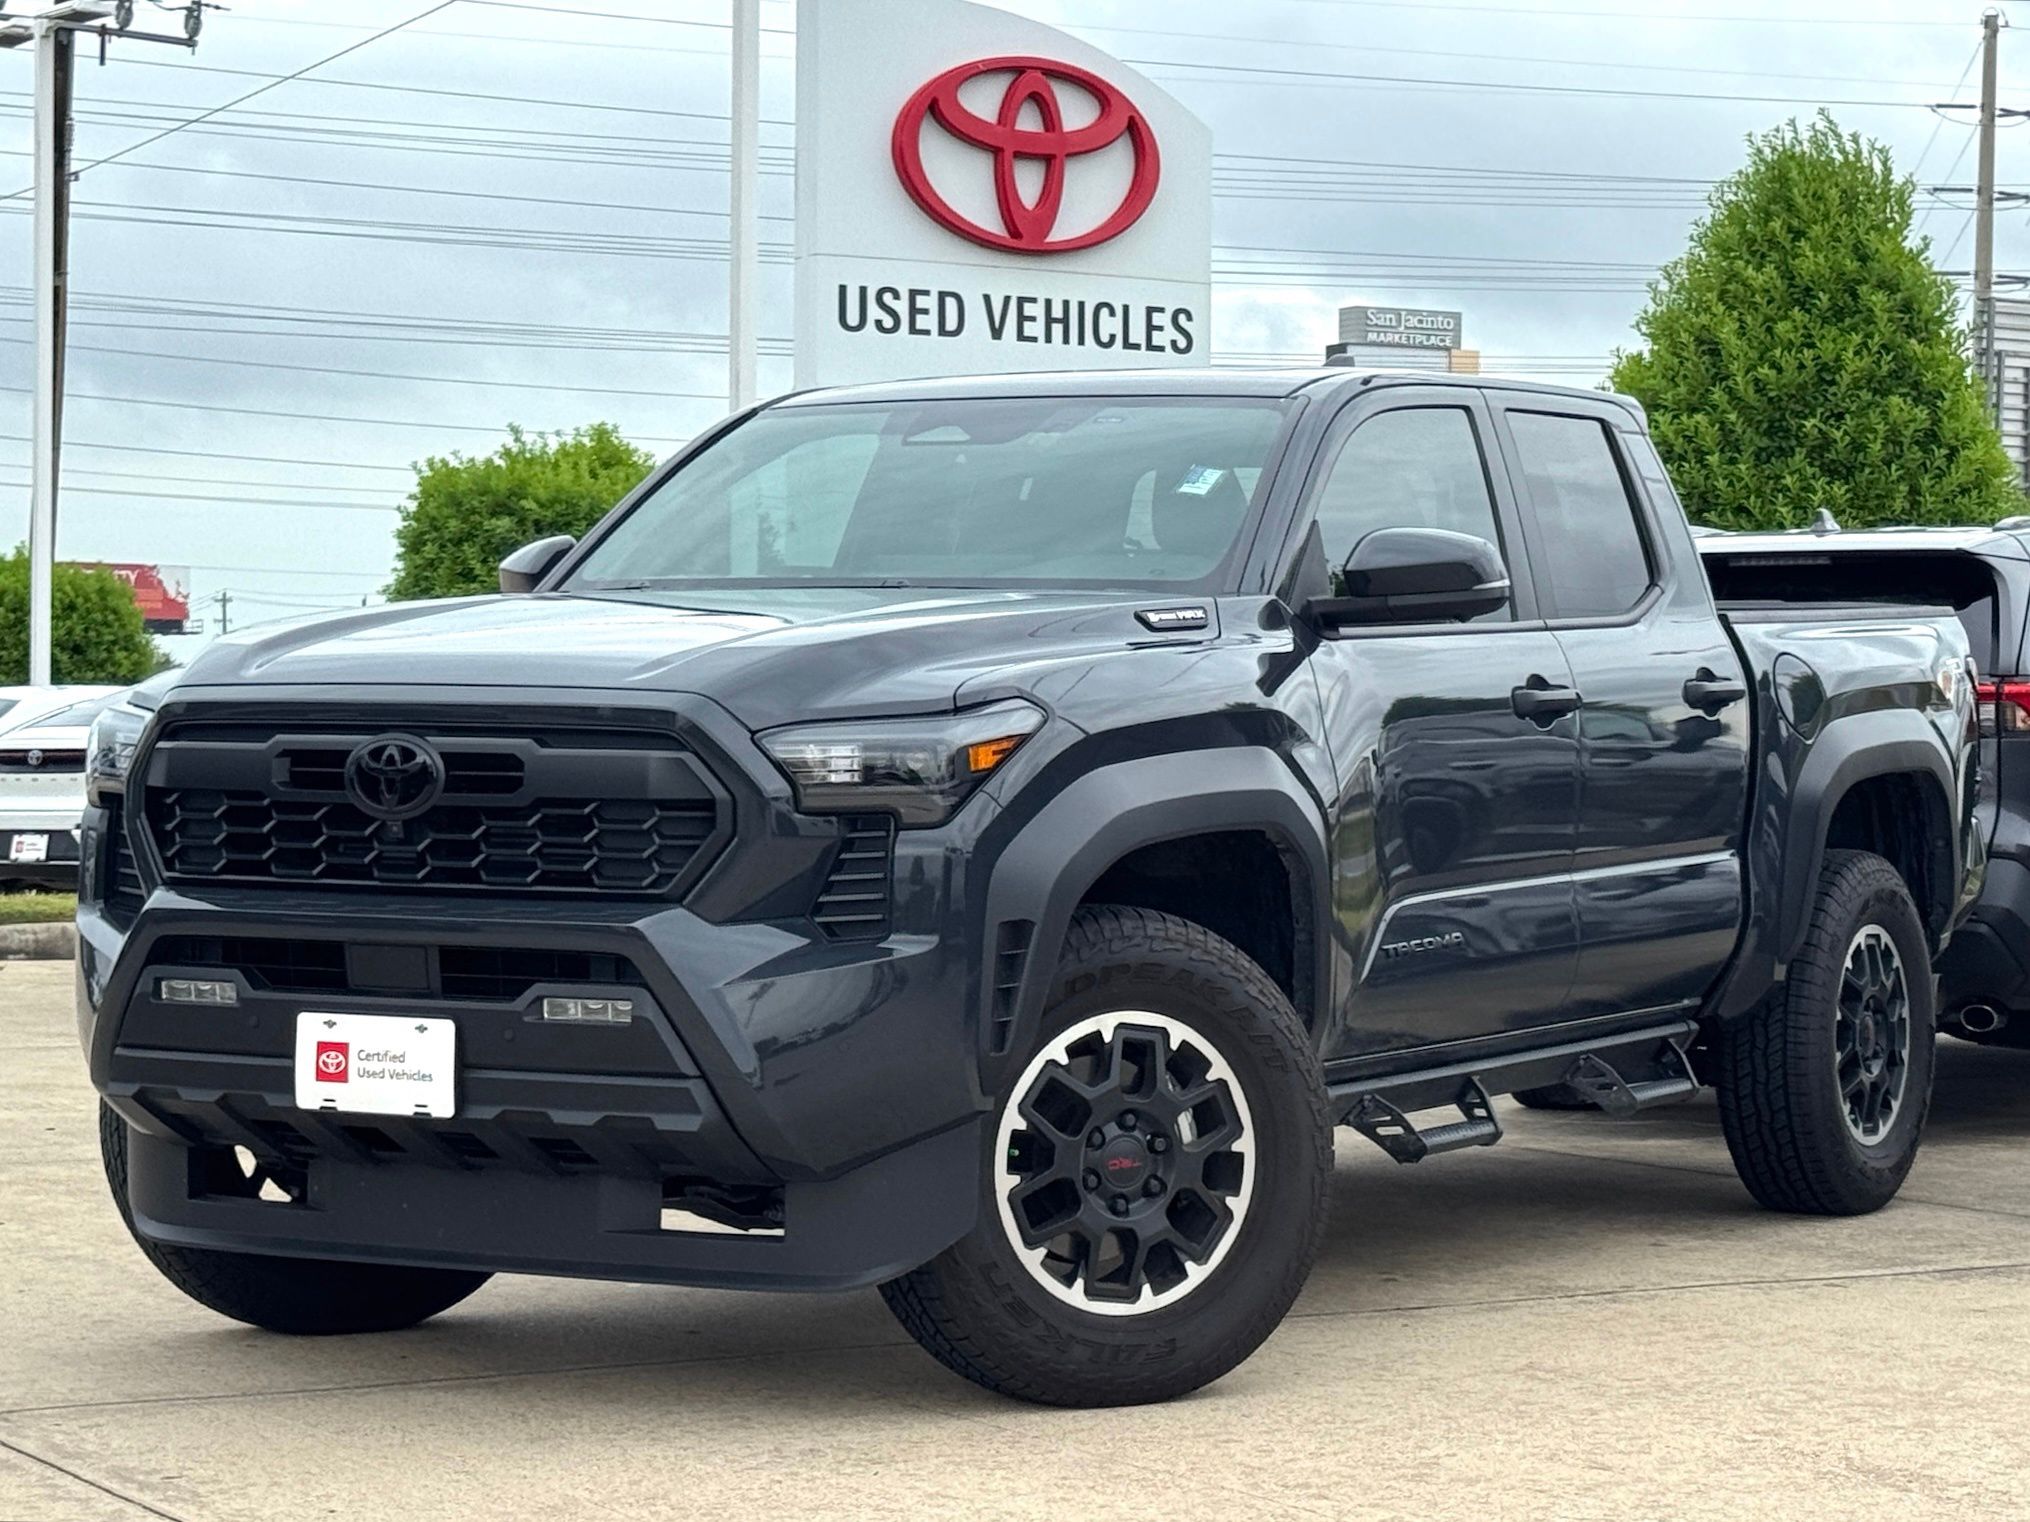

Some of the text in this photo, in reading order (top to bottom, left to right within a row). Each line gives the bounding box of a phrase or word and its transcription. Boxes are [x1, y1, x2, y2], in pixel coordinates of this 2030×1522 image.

[838, 284, 1194, 355] USED VEHICLES
[1366, 309, 1455, 330] San Jacinto
[1366, 332, 1454, 347] MARKETPLACE
[357, 1050, 406, 1063] Certified
[357, 1067, 433, 1082] Used Vehicles
